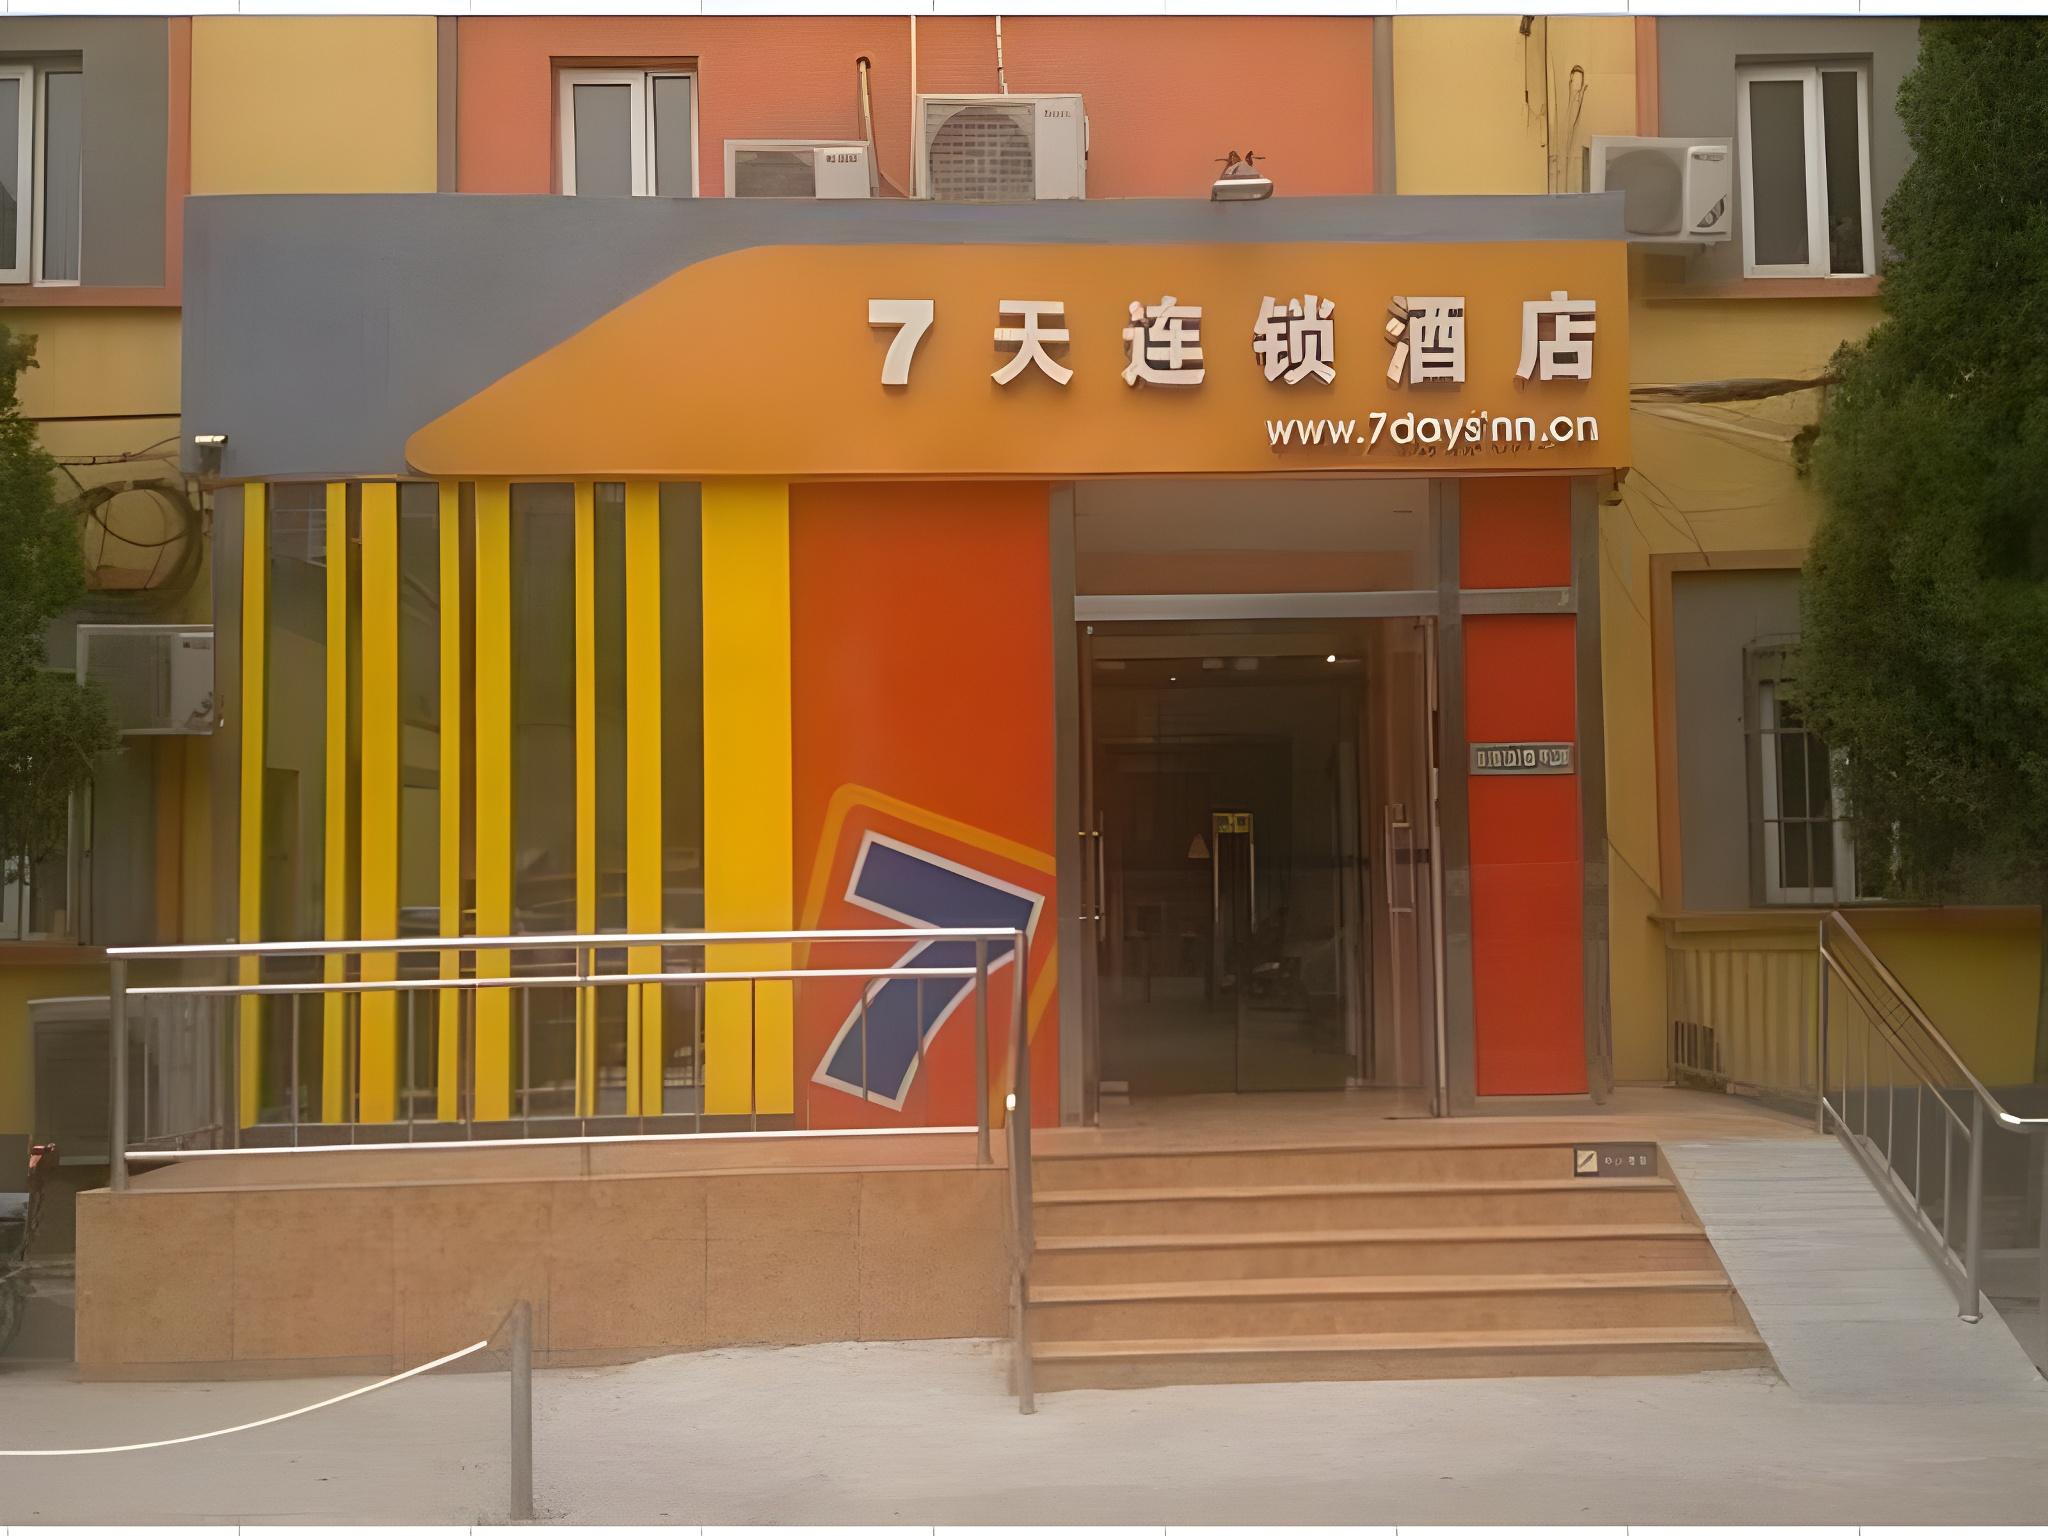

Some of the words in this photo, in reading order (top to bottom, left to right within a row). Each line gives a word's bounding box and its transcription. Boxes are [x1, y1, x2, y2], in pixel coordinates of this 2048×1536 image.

[867, 291, 1597, 388] 7天连锁酒店
[811, 829, 1045, 1112] 7
